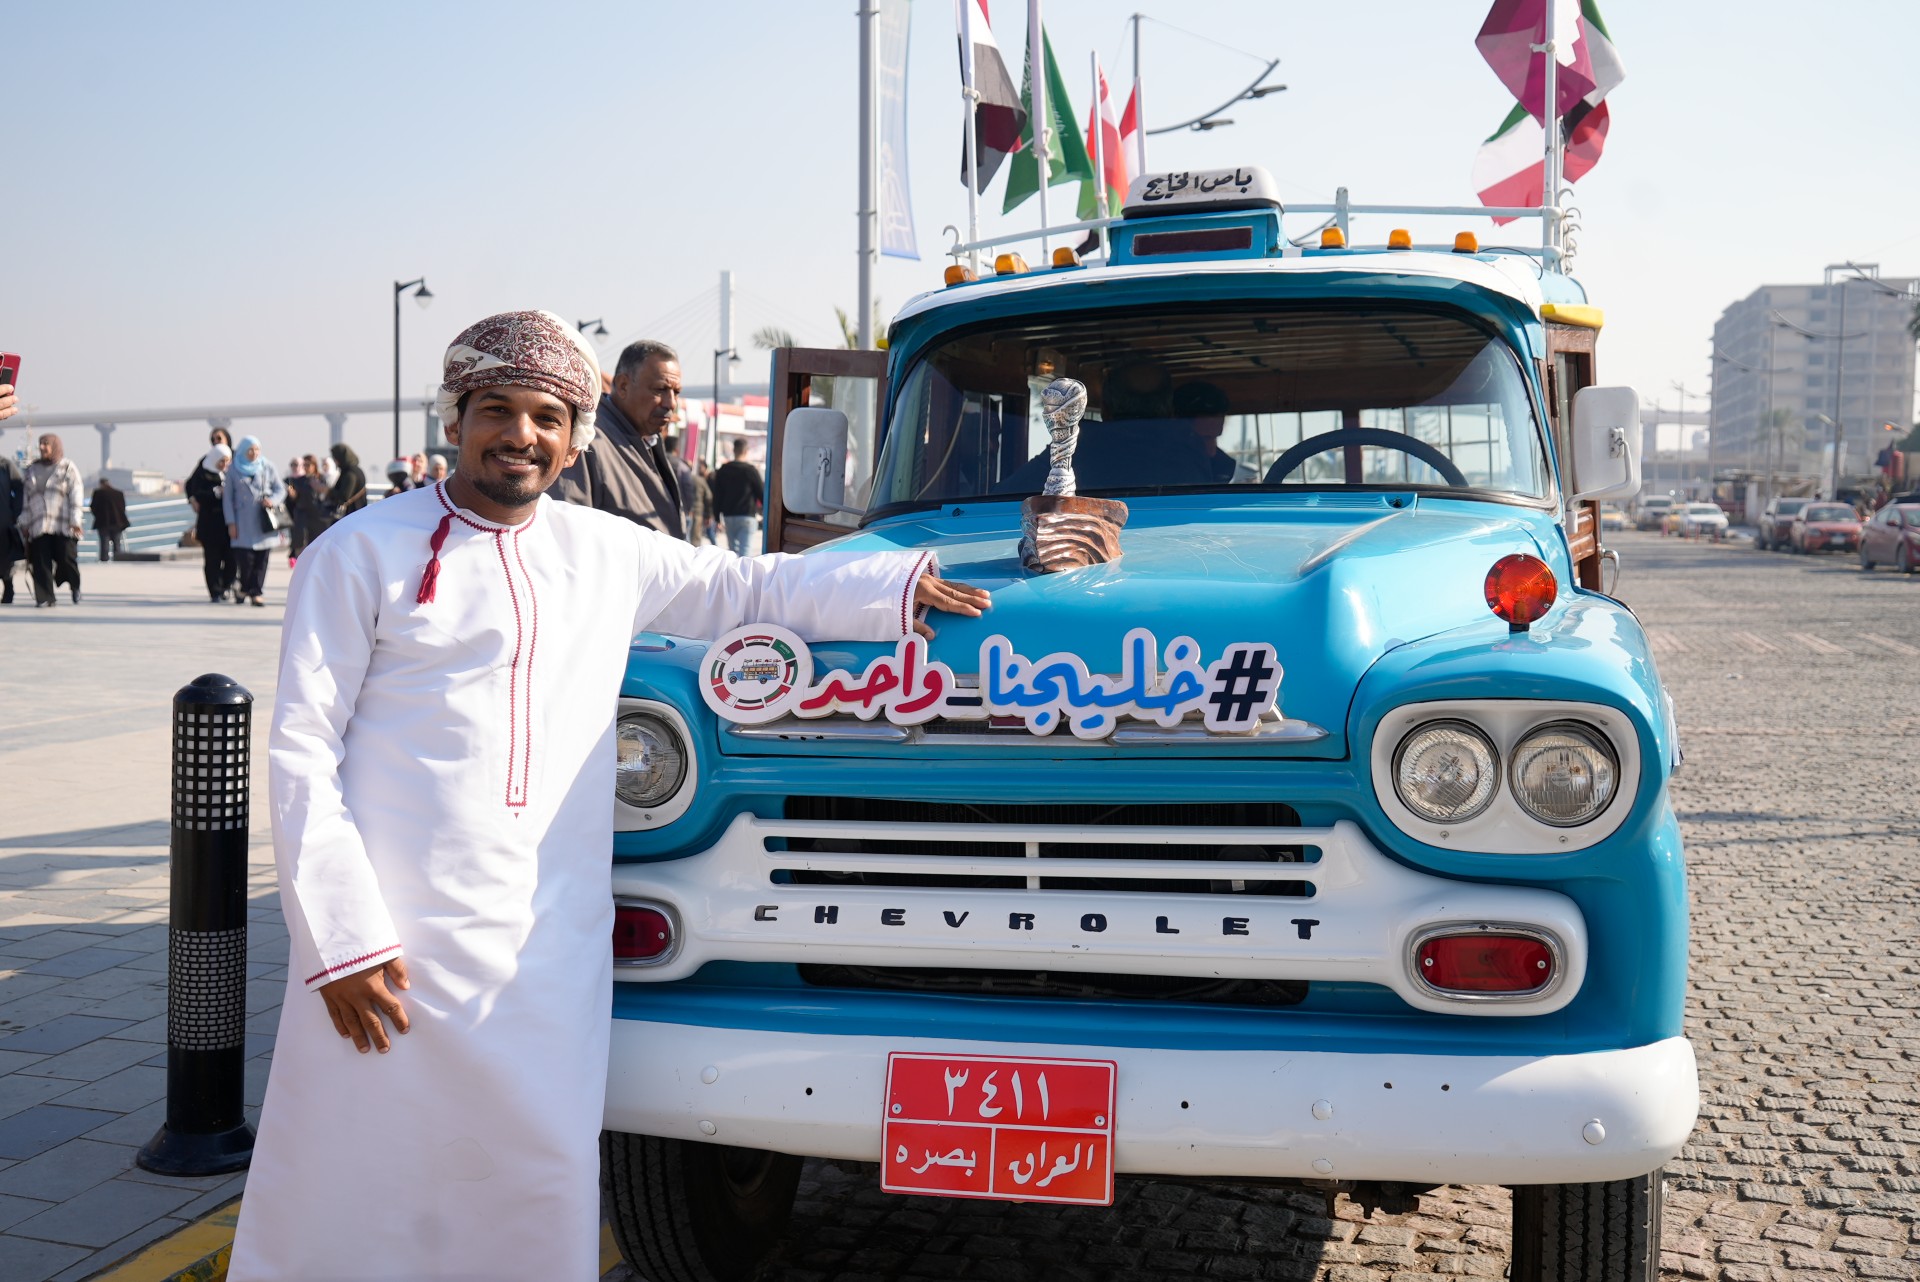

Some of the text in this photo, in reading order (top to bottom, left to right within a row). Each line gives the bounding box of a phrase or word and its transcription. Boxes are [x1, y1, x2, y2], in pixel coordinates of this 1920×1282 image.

[1142, 168, 1253, 202] باص الخليج
[754, 905, 1321, 940] CHEVROLET
[944, 1066, 1049, 1121] ٣٤١١
[1008, 1141, 1095, 1188] العراق
